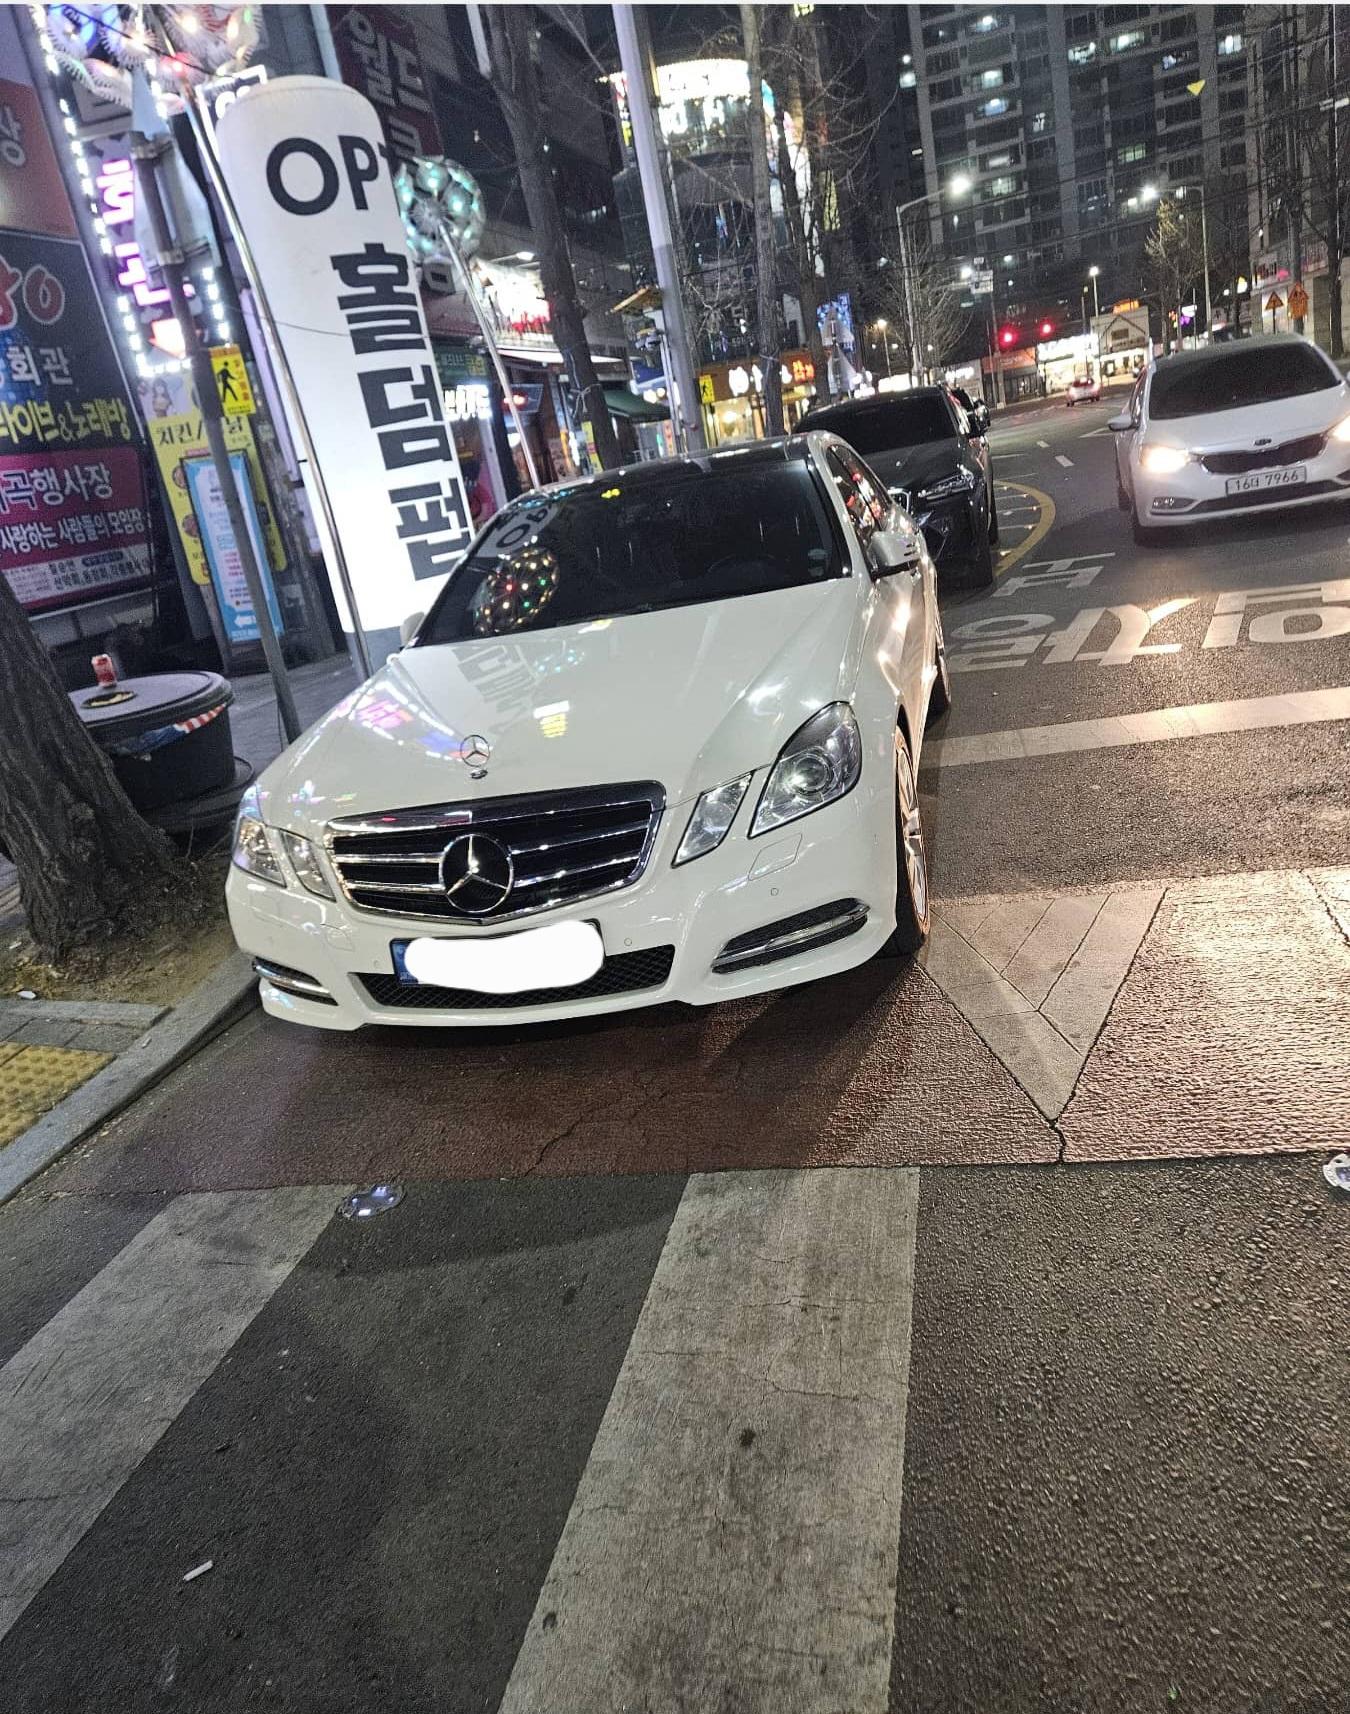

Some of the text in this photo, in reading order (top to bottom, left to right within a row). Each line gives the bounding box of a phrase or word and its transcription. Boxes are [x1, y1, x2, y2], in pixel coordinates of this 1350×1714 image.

[0, 345, 73, 388] 회관
[331, 243, 471, 581] 홀덤펍
[0, 462, 113, 514] 곡행사장
[1265, 471, 1299, 486] 7966
[0, 522, 58, 554] 사랑하는
[59, 514, 111, 545] 사람들의
